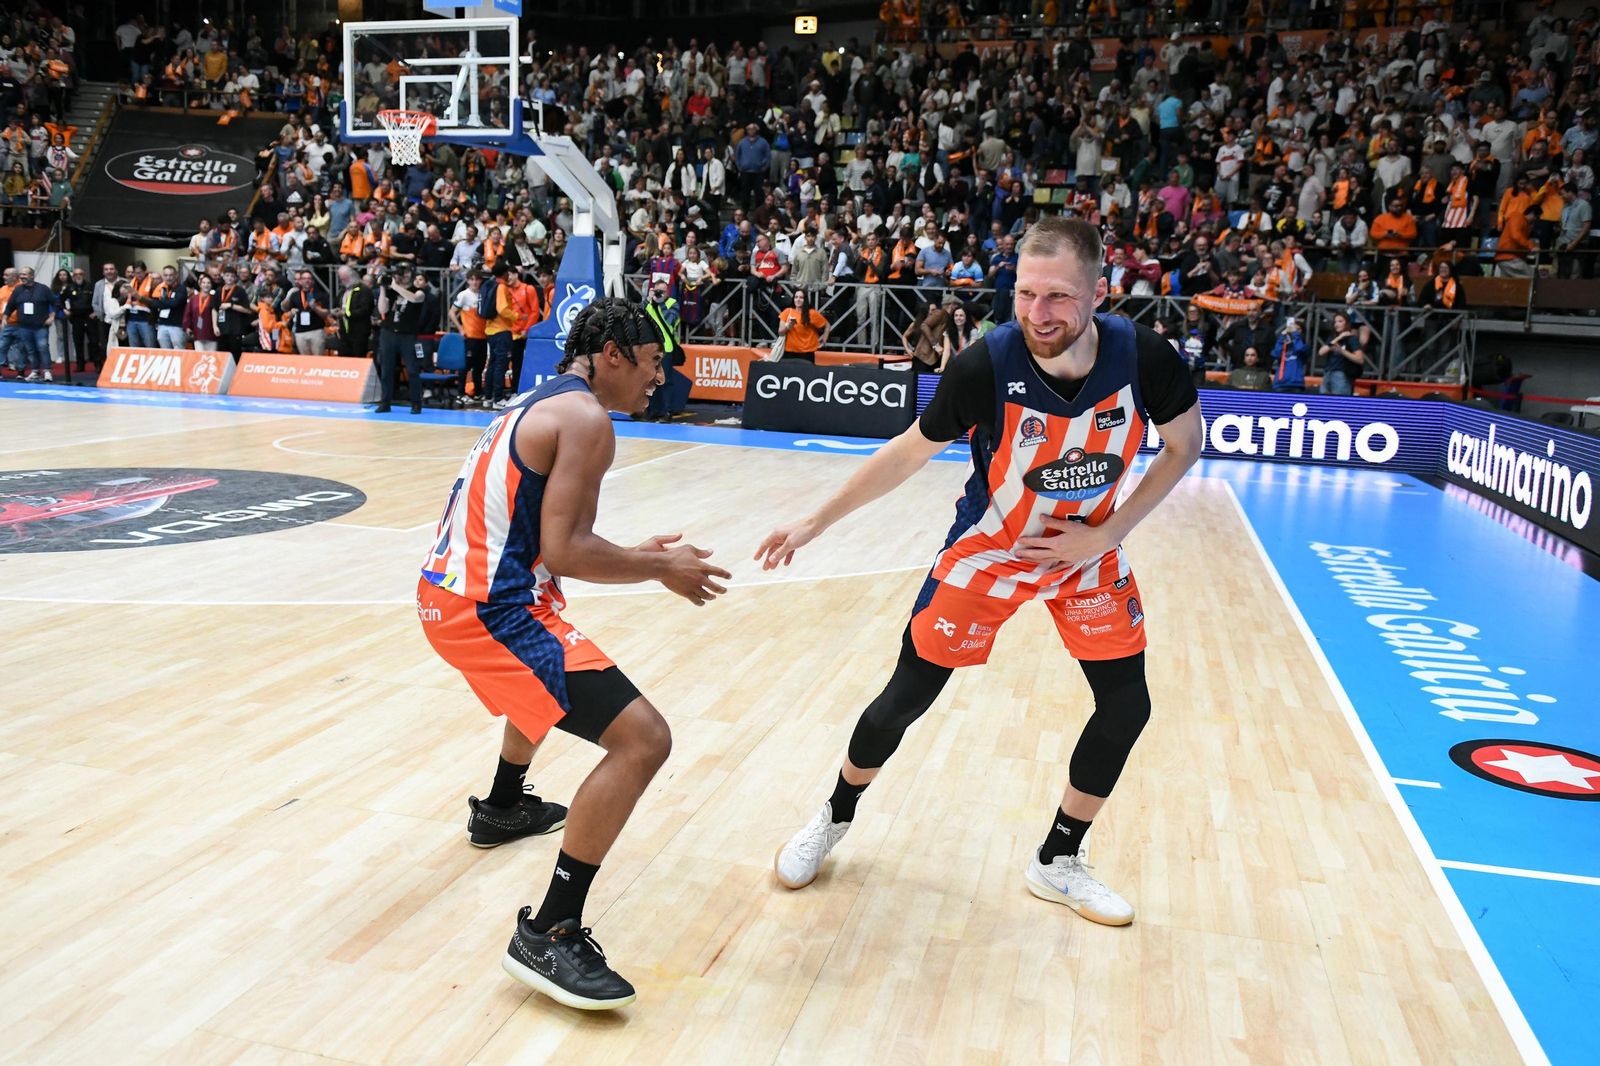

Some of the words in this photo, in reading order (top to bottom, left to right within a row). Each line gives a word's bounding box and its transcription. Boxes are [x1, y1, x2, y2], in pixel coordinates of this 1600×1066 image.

[133, 155, 238, 173] Estrella
[133, 167, 228, 184] Galicia
[110, 353, 181, 387] LEYMA
[243, 363, 296, 375] OMODA
[304, 368, 359, 379] JAECOO
[695, 357, 743, 380] LEYMA
[756, 372, 907, 408] endesa
[1099, 418, 1125, 429] endesa
[1040, 460, 1109, 480] Estrella
[1447, 423, 1593, 530] azulmarino
[1043, 473, 1106, 490] Galicia
[1116, 578, 1127, 588] acb
[1308, 541, 1439, 611] Estrella
[1081, 607, 1118, 621] DESCUBRIR
[1083, 600, 1118, 614] PROVINCIA
[1366, 613, 1558, 725] Galicia
